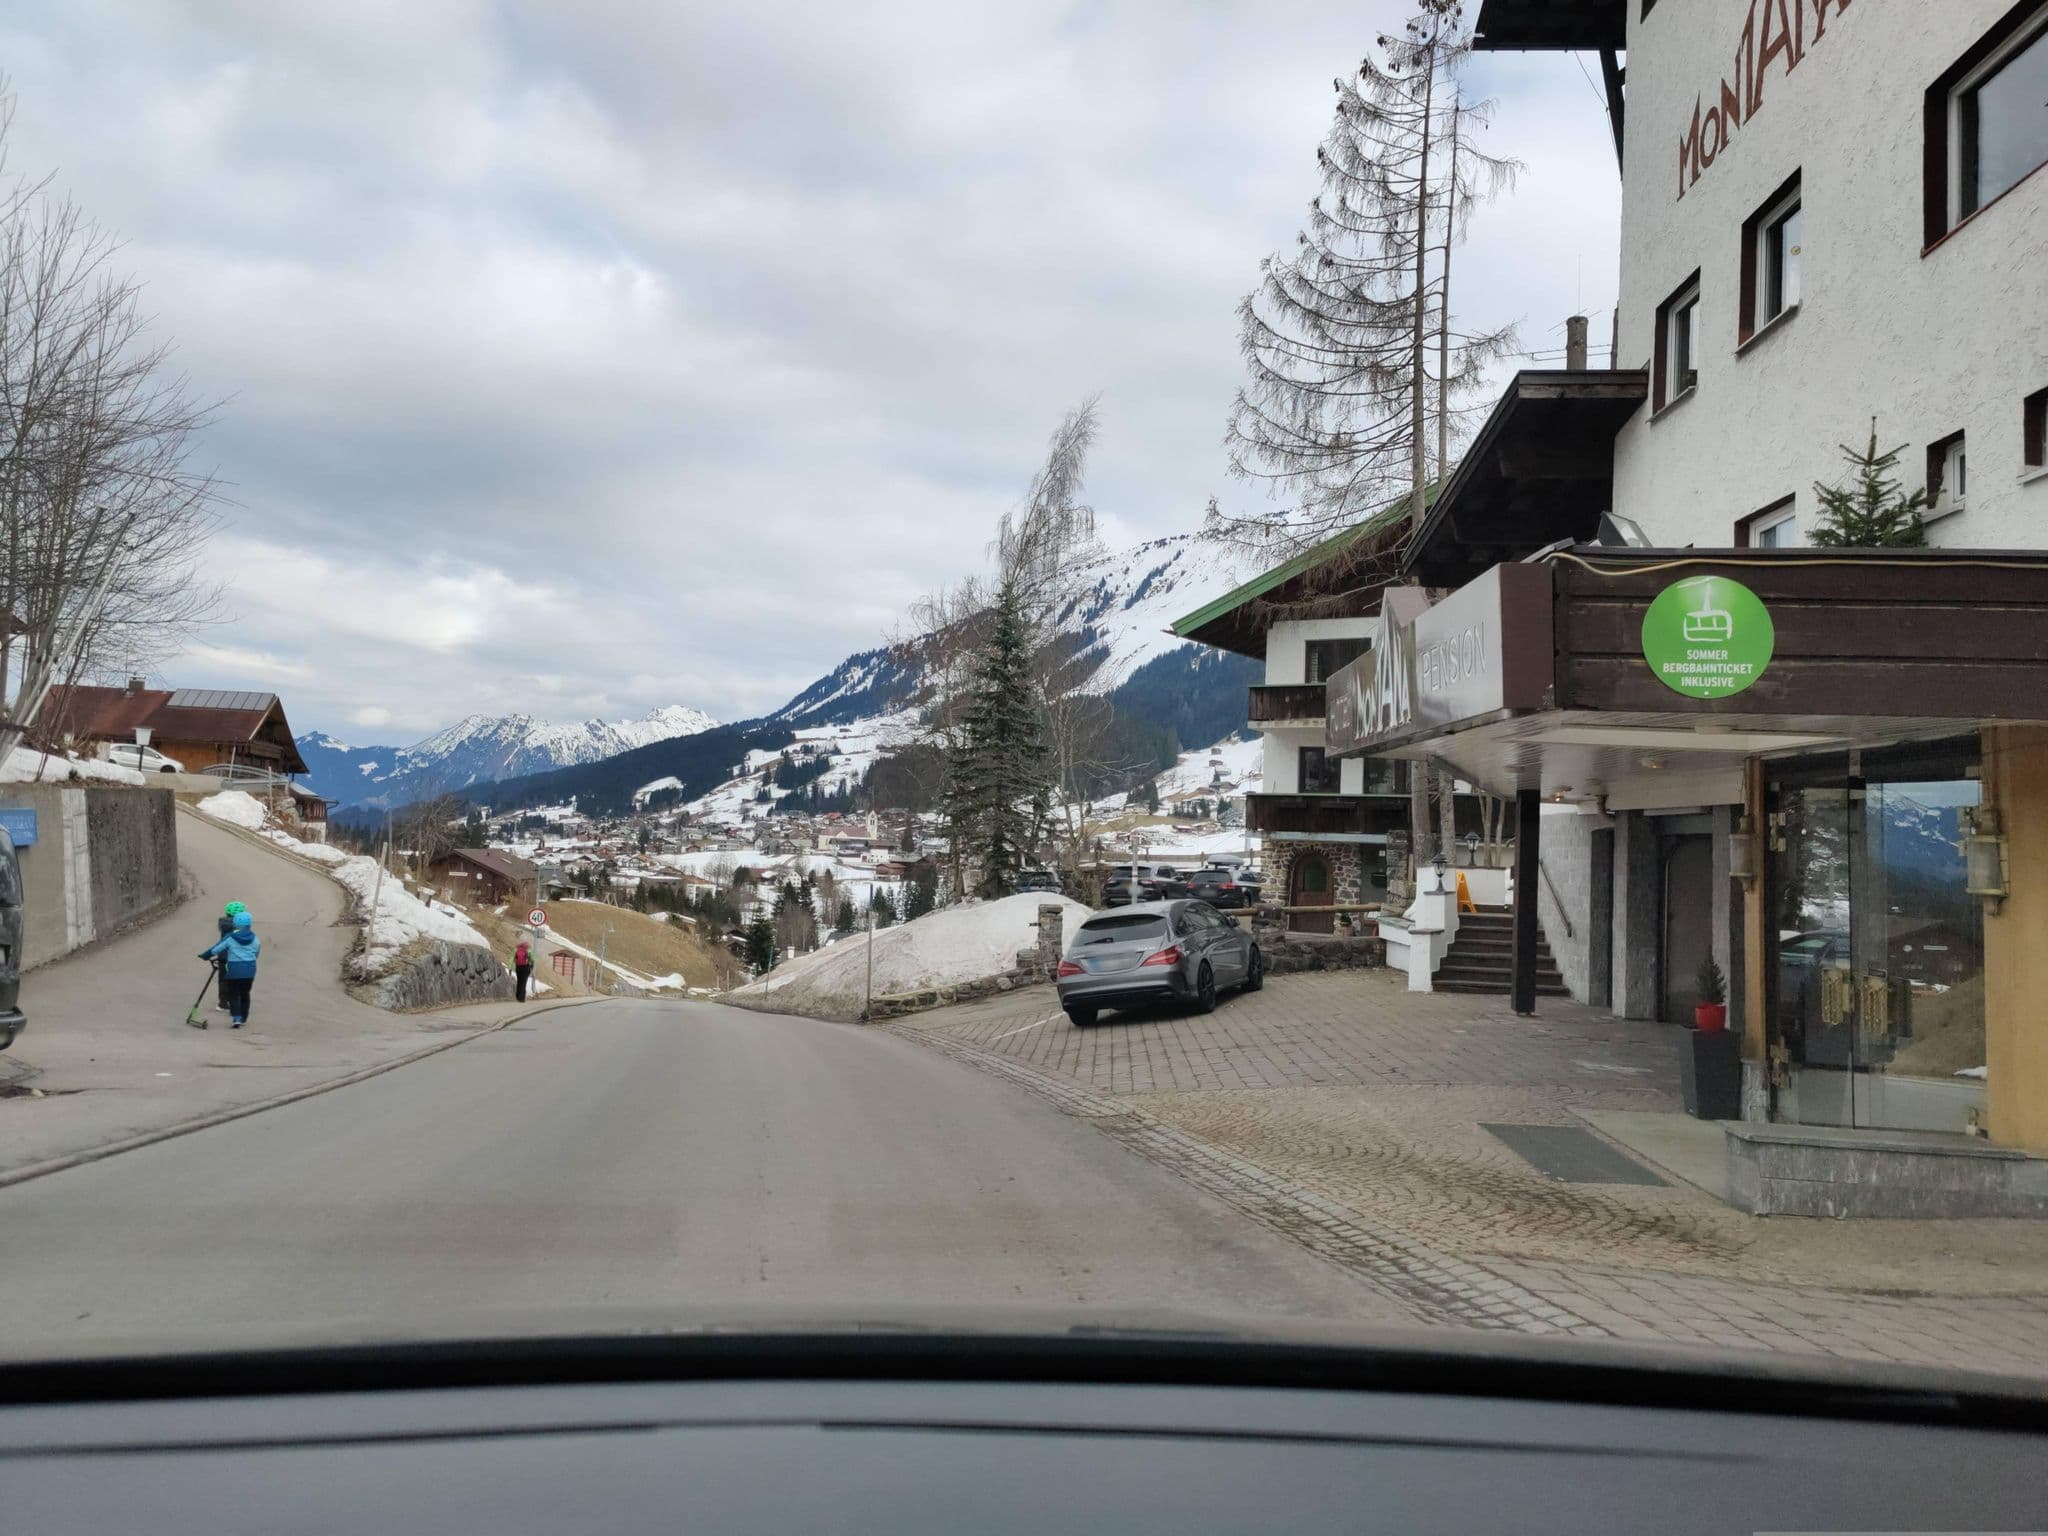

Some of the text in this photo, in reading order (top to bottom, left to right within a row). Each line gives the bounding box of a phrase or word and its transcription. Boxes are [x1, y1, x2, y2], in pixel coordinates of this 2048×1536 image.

[1422, 620, 1486, 697] PENSION
[1686, 649, 1728, 660] SOMMER
[1662, 662, 1753, 674] BERGBAHNTICKET
[1681, 676, 1734, 687] INKLUSIVE
[532, 912, 543, 922] 40
